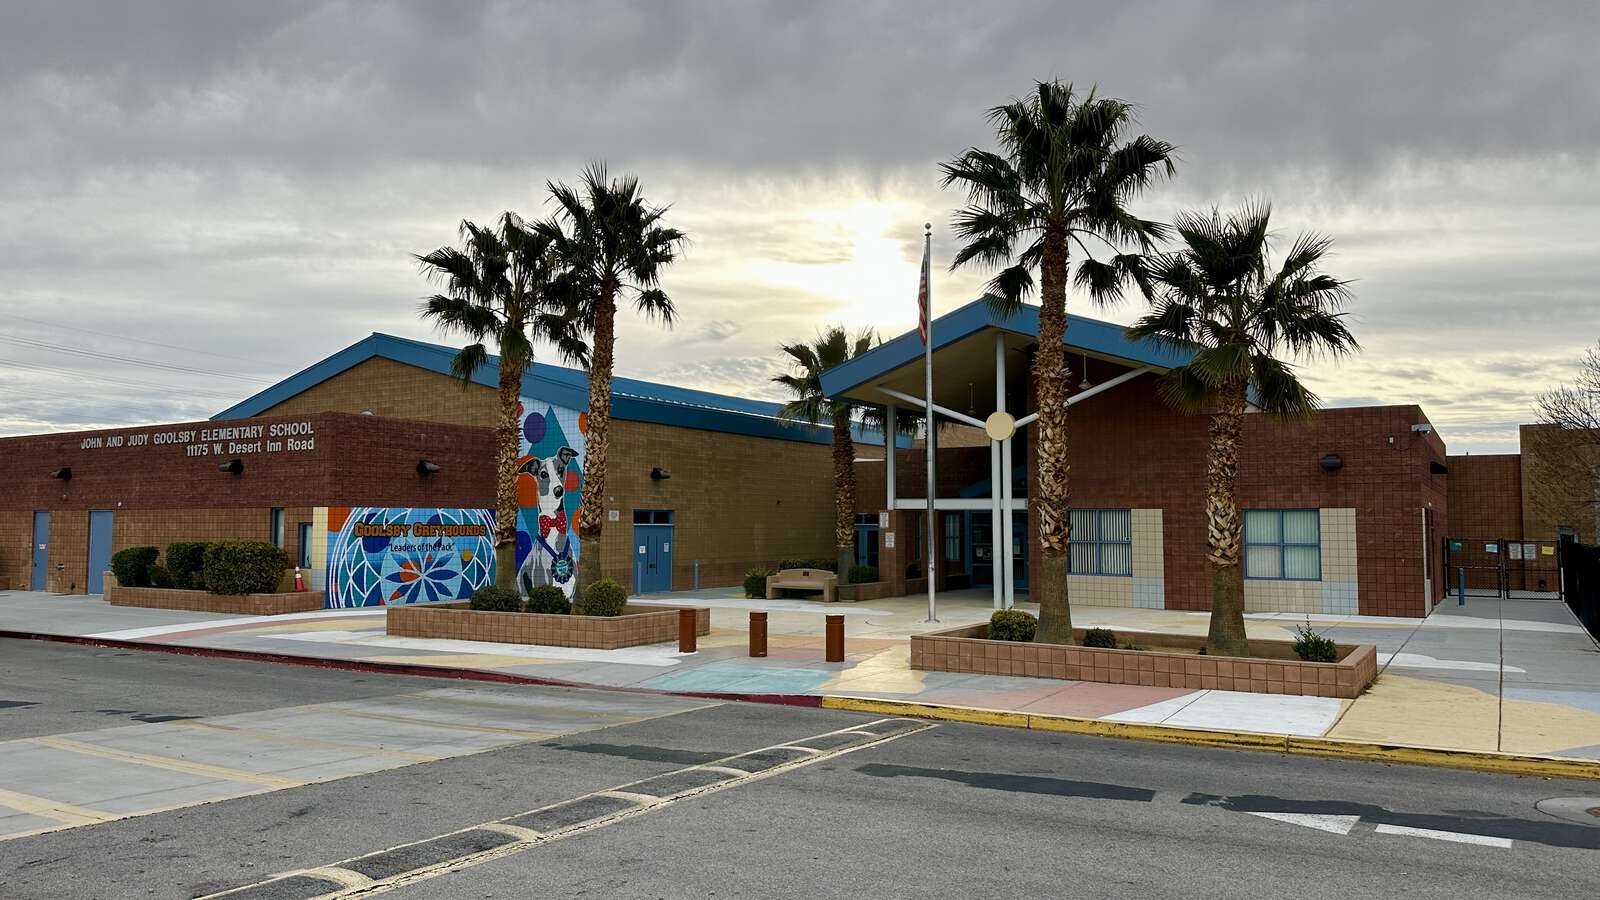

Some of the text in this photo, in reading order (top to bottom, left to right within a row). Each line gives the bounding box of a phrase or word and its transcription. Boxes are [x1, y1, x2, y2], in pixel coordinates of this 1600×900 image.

[80, 422, 314, 449] JOHN AND JUDY GOOLSBY ELEMENTARY SCHOOL
[186, 437, 315, 457] 11175 W. Desert Inn Road
[354, 521, 487, 537] GOOLSBY GREYHOUNDS
[417, 543, 425, 552] of
[425, 542, 436, 551] the
